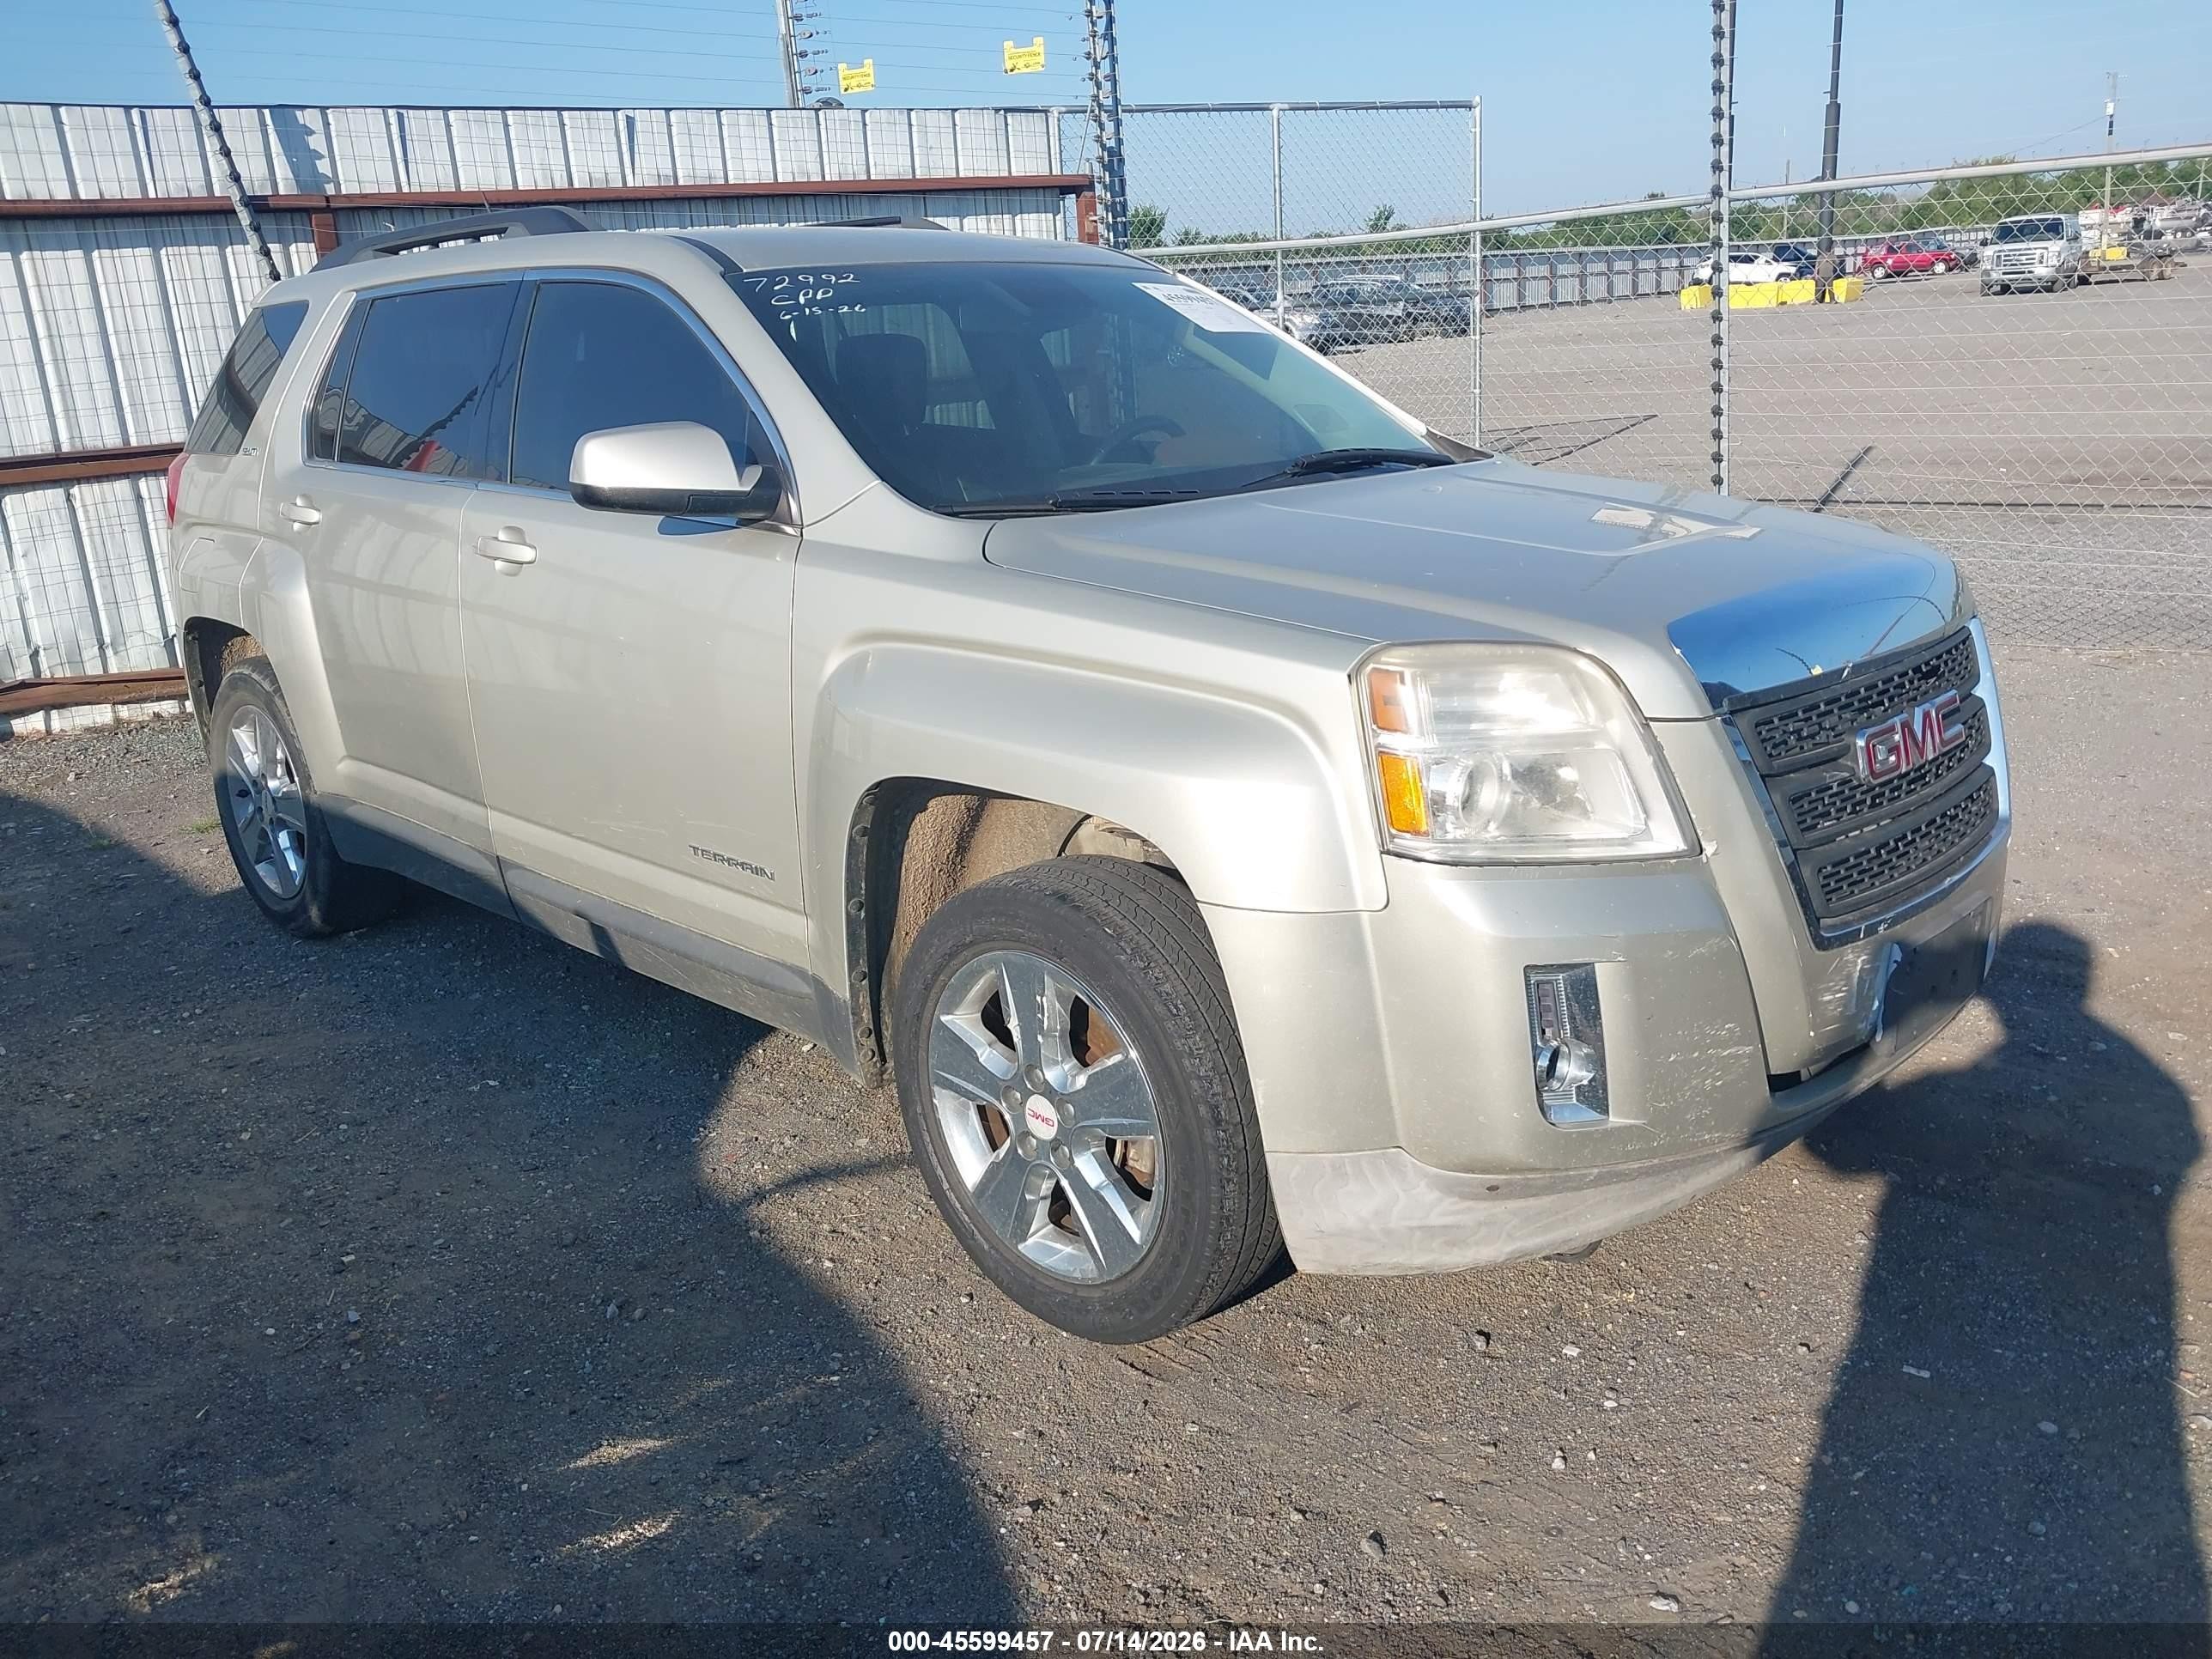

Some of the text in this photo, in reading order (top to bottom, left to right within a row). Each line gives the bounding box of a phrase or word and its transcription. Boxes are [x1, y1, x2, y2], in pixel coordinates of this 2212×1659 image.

[743, 273, 861, 293] 72992
[1856, 689, 1966, 785] GMC
[687, 844, 776, 882] TERRAIN
[1027, 1107, 1054, 1127] GMC
